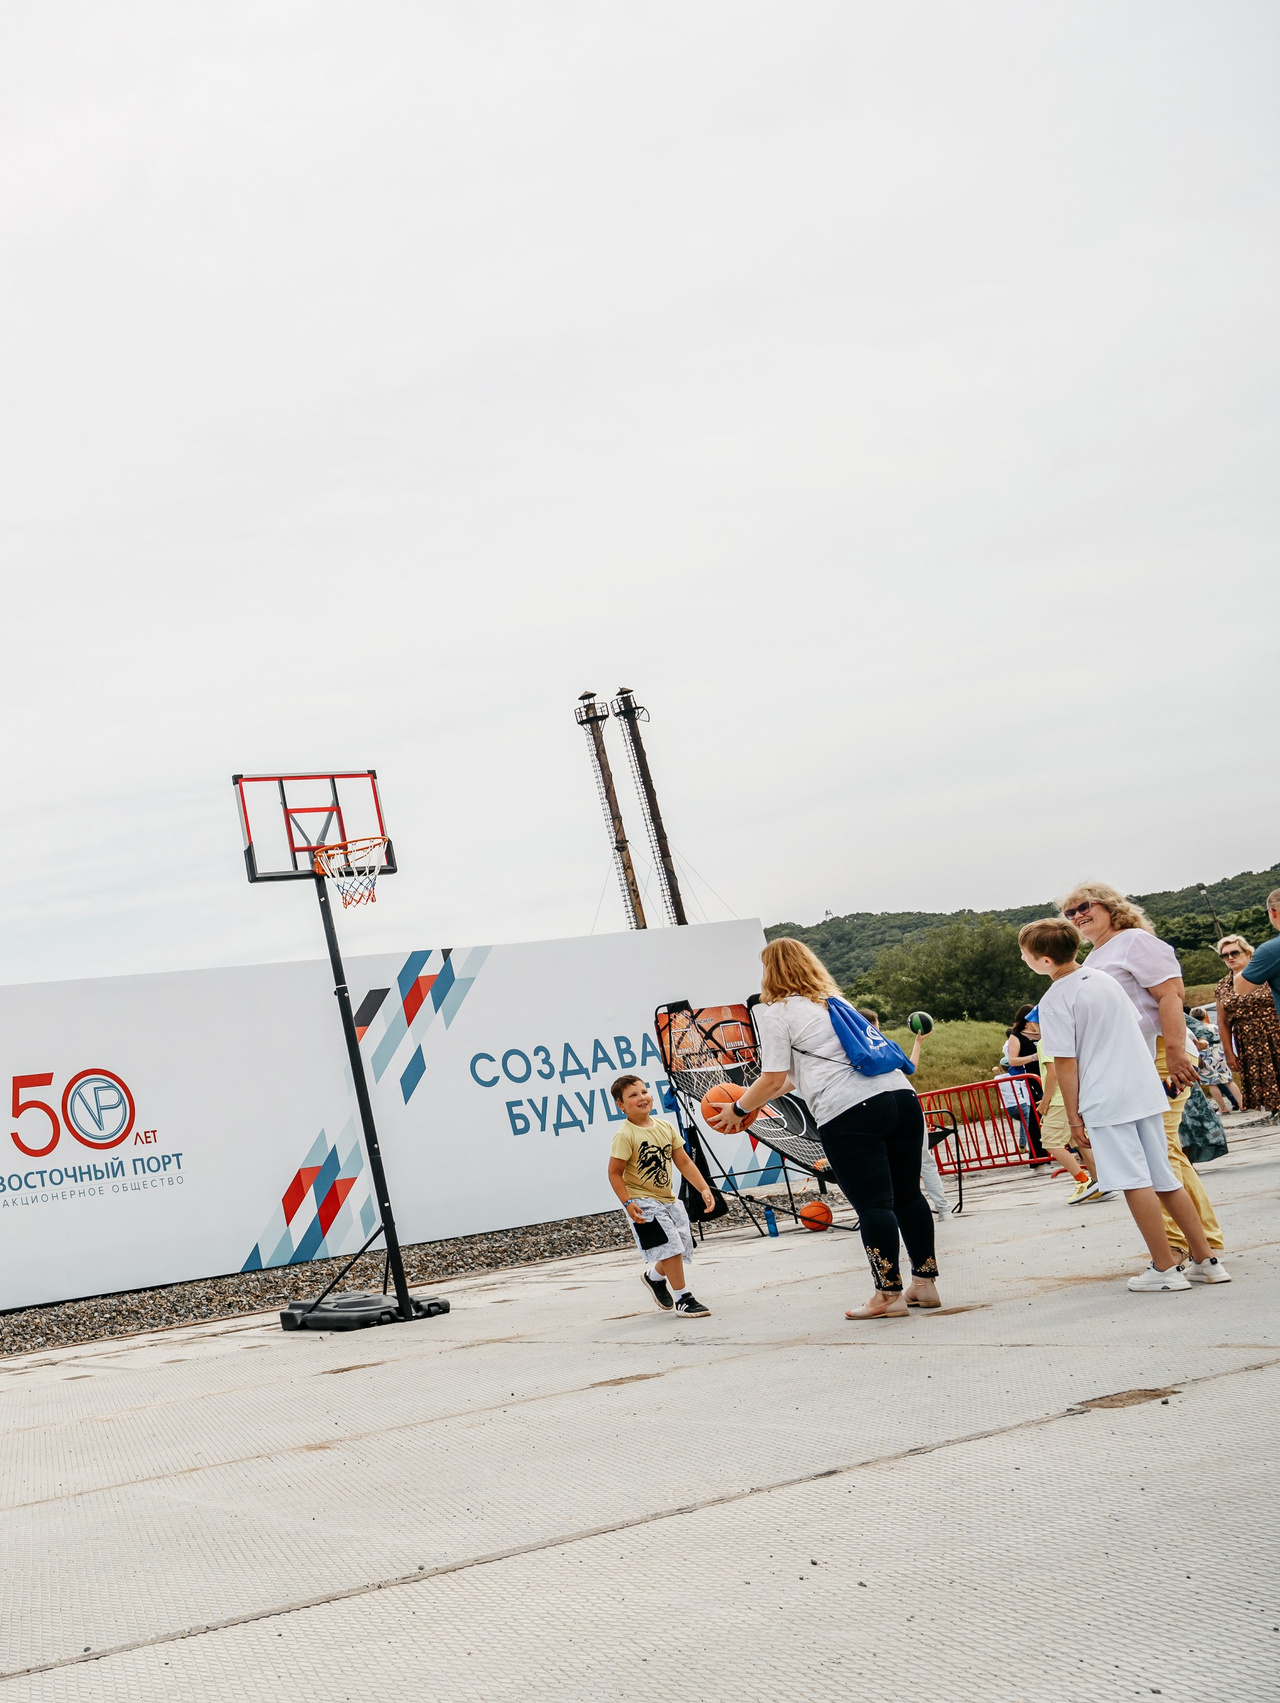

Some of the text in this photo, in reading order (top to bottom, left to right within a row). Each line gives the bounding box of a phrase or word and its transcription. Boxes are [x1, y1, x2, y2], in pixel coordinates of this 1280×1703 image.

[470, 1033, 663, 1088] СОЗДАВА
[10, 1068, 158, 1158] 50 ЛЕТ
[131, 1152, 184, 1175] ПОРТ
[2, 1175, 185, 1208] АКЦИОНЕРНОЕ ОБЩЕСТВО
